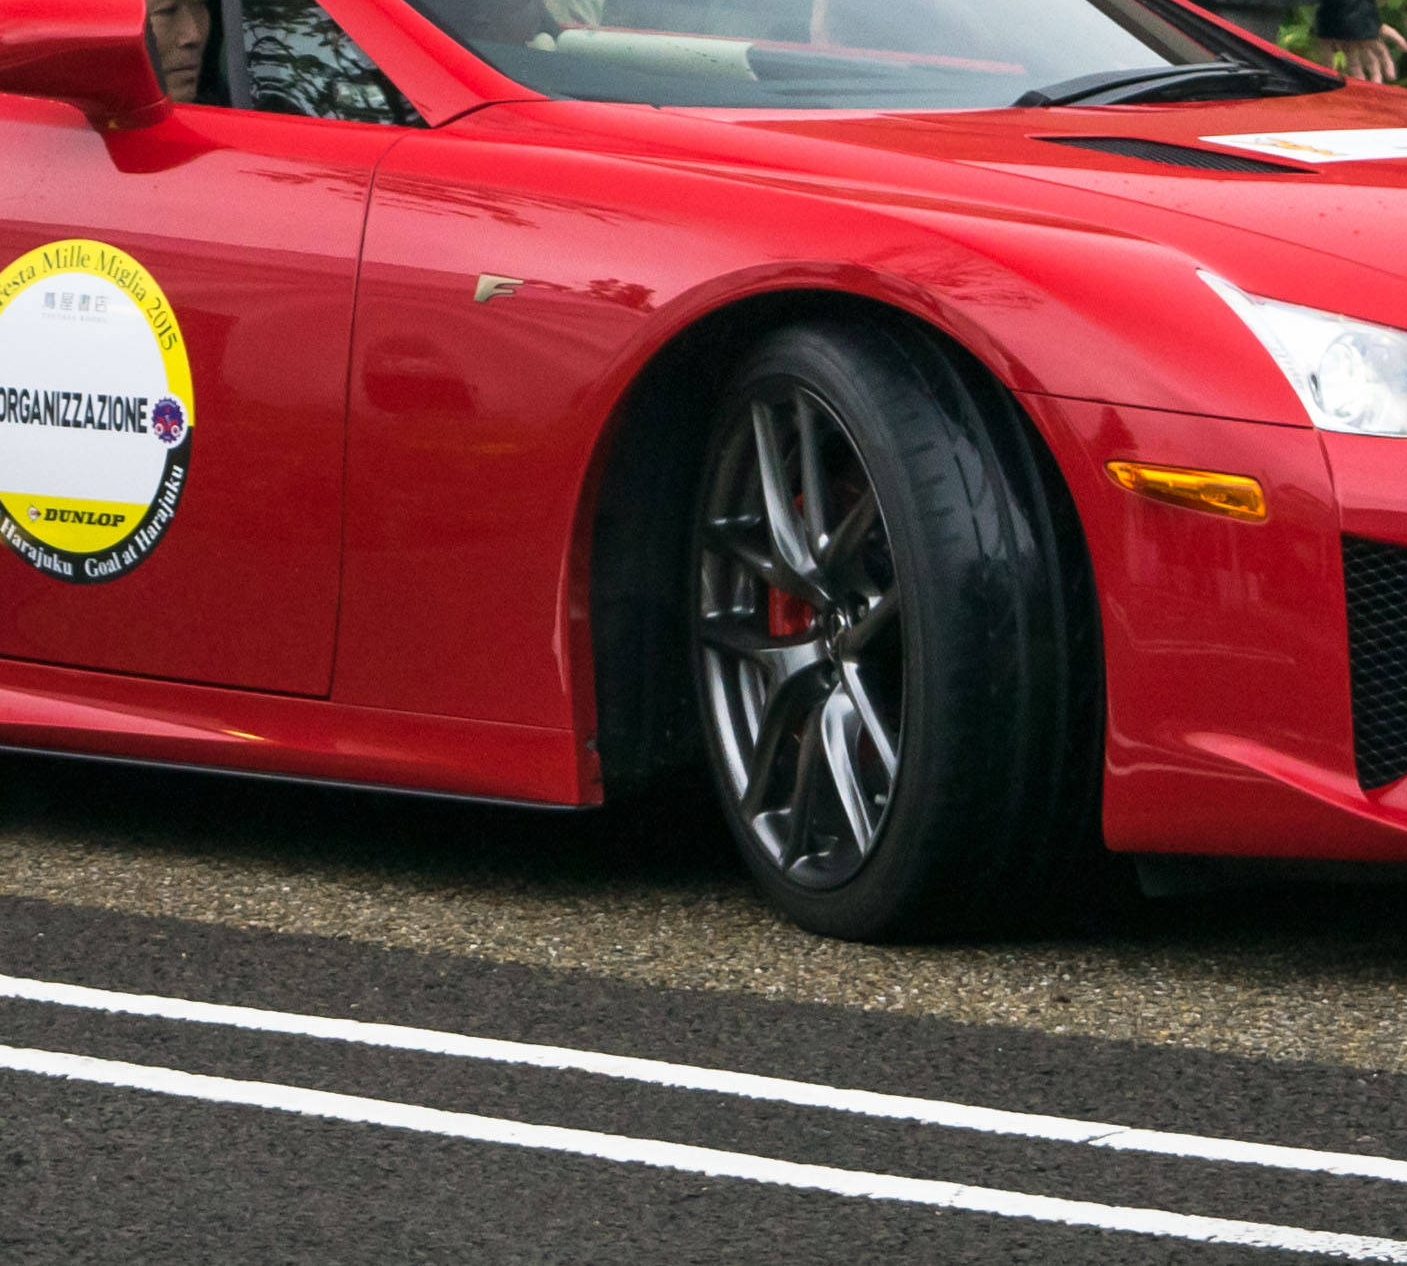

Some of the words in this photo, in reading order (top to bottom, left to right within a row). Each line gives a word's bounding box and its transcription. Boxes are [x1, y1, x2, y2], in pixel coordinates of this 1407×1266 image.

[42, 245, 91, 273] Mille
[94, 250, 148, 302] Miglia
[146, 297, 178, 351] 2015
[0, 519, 74, 577] Harajuku
[43, 507, 126, 527] DUNLOP
[84, 557, 124, 578] Goal
[121, 546, 139, 567] at
[134, 464, 184, 552] Harajuku
